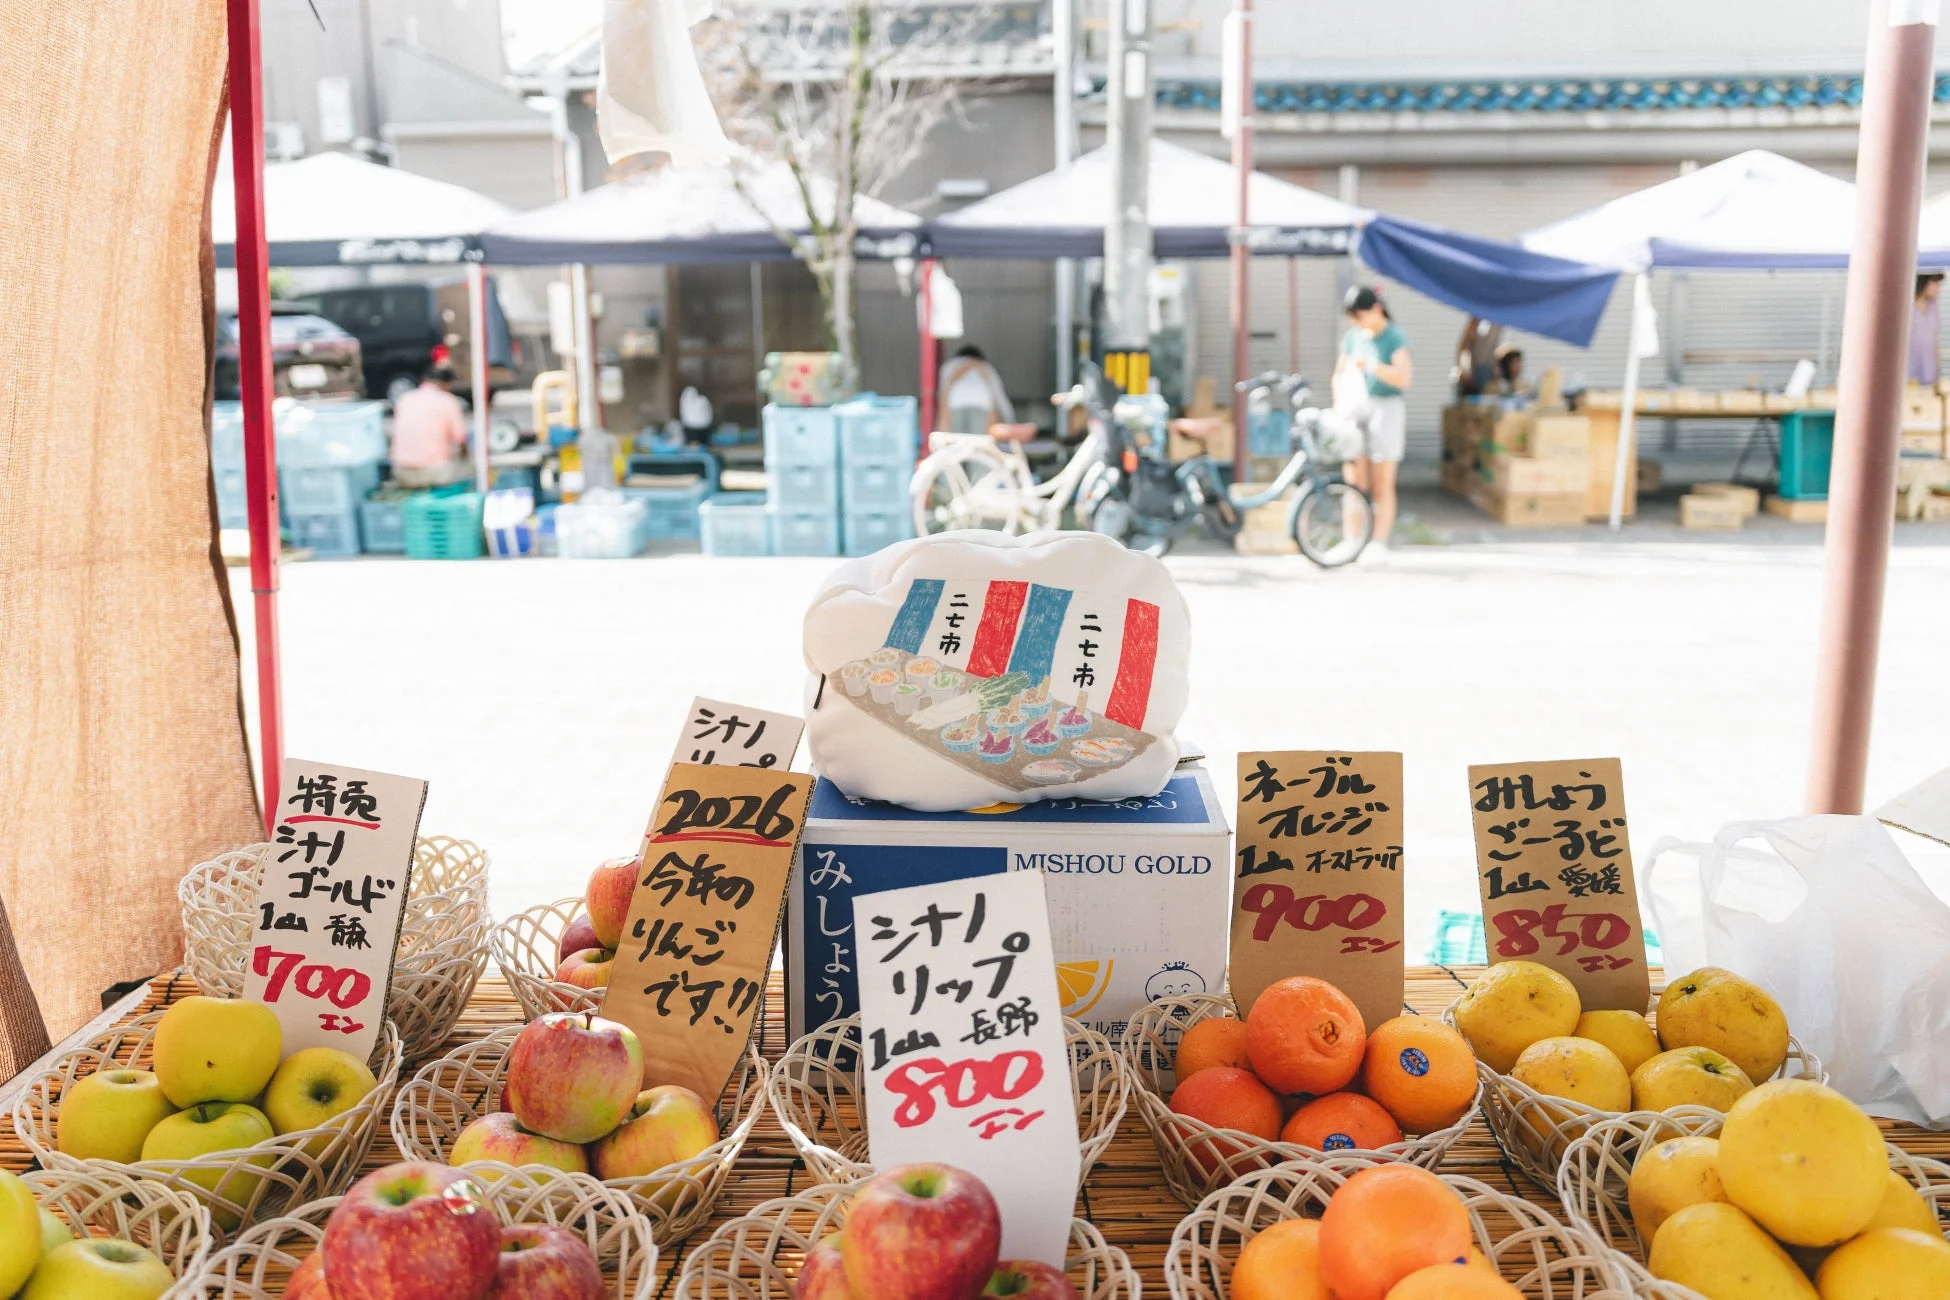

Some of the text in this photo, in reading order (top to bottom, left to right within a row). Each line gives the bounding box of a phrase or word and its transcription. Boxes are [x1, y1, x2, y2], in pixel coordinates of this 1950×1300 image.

[940, 594, 968, 655] 二七市
[1073, 614, 1101, 688] 二七市
[693, 708, 766, 749] シナノ
[288, 774, 381, 821] 特売
[1241, 756, 1376, 802] ネーブル
[1475, 771, 1606, 812] みしょう
[656, 784, 797, 840] 2026
[1257, 802, 1390, 839] オレンジ
[276, 826, 345, 866] シナノ
[1237, 845, 1294, 878] 1山
[1488, 817, 1626, 861] ごーるど
[642, 851, 754, 910] 今年の
[1014, 853, 1212, 875] MISHOU GOLD
[1484, 862, 1624, 899] 1山 愛媛
[289, 867, 395, 913] ゴールド
[1241, 883, 1386, 941] 900
[260, 902, 371, 949] 1山 青森
[632, 918, 736, 966] りんご
[871, 893, 986, 963] シナノ
[1340, 937, 1401, 953] エン
[1492, 904, 1631, 957] 850
[253, 945, 370, 1009] 700
[893, 932, 1031, 1015] リップ
[1577, 954, 1633, 972] エン
[318, 1014, 364, 1034] エン
[869, 997, 1039, 1071] 1山 長野
[884, 1050, 1045, 1128] 800
[969, 1108, 1045, 1139] エン
